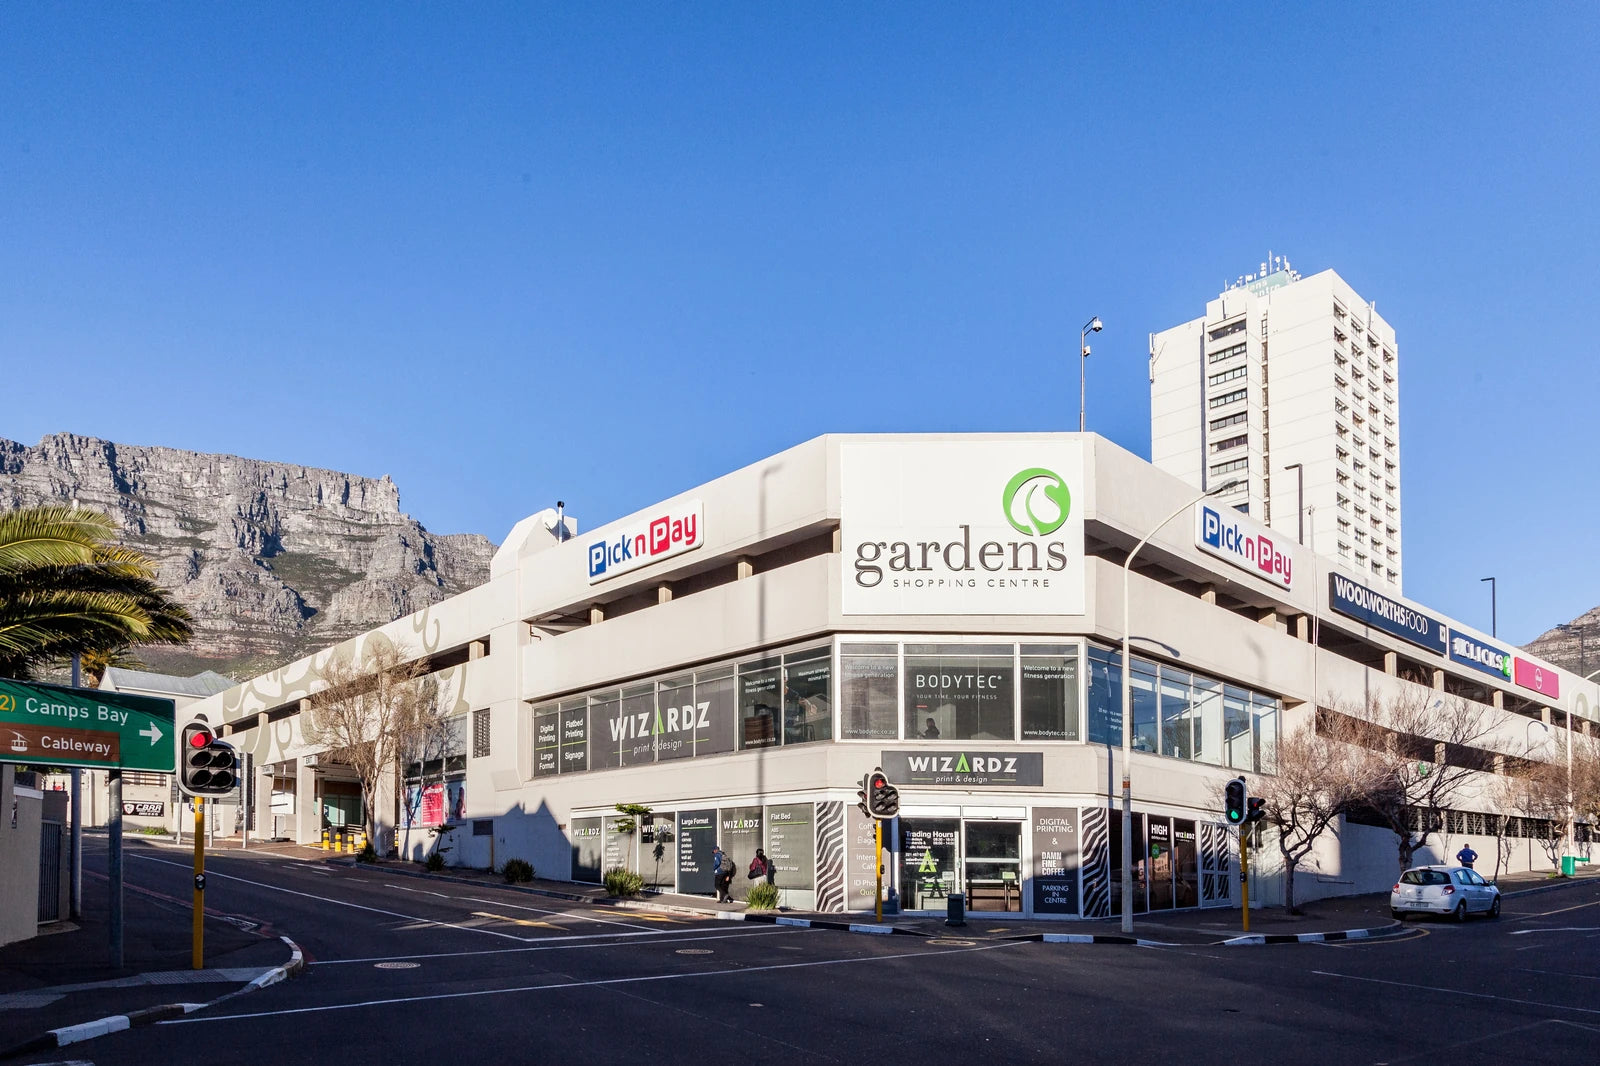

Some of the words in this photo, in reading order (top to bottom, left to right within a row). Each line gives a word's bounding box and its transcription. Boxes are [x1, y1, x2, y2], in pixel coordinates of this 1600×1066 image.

[589, 534, 632, 577] Pick
[635, 534, 646, 557] n
[650, 513, 696, 556] Pay
[1203, 505, 1243, 556] Pick
[1245, 537, 1255, 561] n
[1257, 534, 1292, 585] Pay
[854, 524, 1068, 588] gardens
[893, 578, 976, 588] SHOPPING
[987, 578, 1050, 588] CENTRE
[916, 674, 998, 689] BODYTEC
[25, 697, 89, 721] Camps
[97, 705, 129, 726] Bay
[609, 701, 711, 742] WIZARDZ
[540, 723, 555, 734] Digital
[1023, 729, 1076, 737] www.bodytec.co.za
[565, 729, 584, 738] Printing
[539, 734, 556, 743] Printing
[41, 735, 111, 756] Cableway
[633, 743, 650, 757] print
[658, 738, 682, 751] design
[540, 753, 554, 761] Large
[564, 751, 585, 760] Signage
[907, 752, 1018, 773] WIZARDZ
[935, 775, 953, 784] print
[955, 775, 961, 783] &
[963, 775, 988, 784] design
[771, 813, 780, 821] Flat
[781, 812, 791, 820] Bed
[723, 817, 760, 829] WIZARDZ
[1040, 818, 1070, 826] DIGITAL
[1036, 825, 1073, 833] PRINTING
[1151, 824, 1168, 836] HIGH
[905, 830, 932, 839] Trading
[932, 830, 954, 838] Hours
[1175, 831, 1195, 840] WIZARDZ
[1052, 837, 1058, 845] &
[1041, 851, 1062, 860] DAMN
[1041, 860, 1057, 868] FINE
[1041, 868, 1065, 876] COFFEE
[853, 879, 862, 887] ID
[859, 888, 877, 896] Quic
